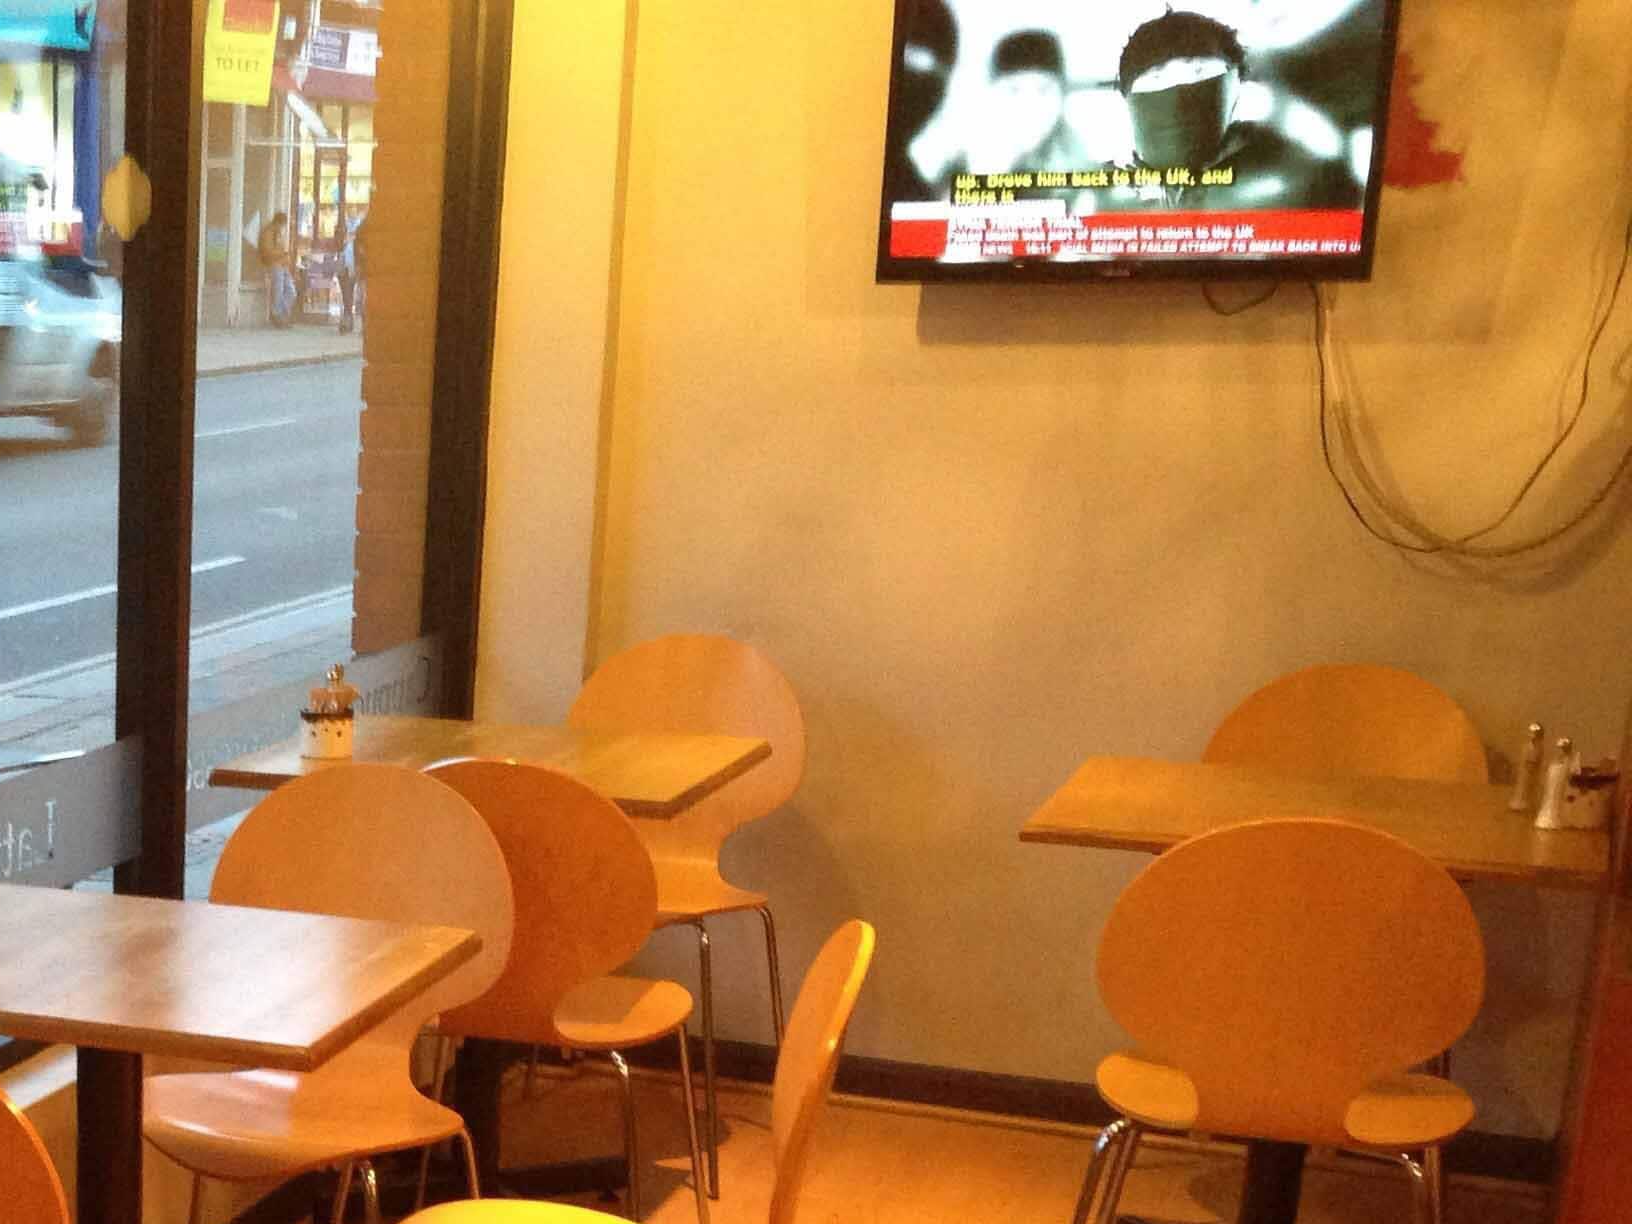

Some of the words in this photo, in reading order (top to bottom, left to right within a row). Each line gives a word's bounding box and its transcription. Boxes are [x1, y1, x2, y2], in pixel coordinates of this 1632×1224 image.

[1112, 168, 1130, 185] to
[1134, 167, 1162, 185] the
[1201, 166, 1233, 185] and
[1211, 224, 1233, 239] the
